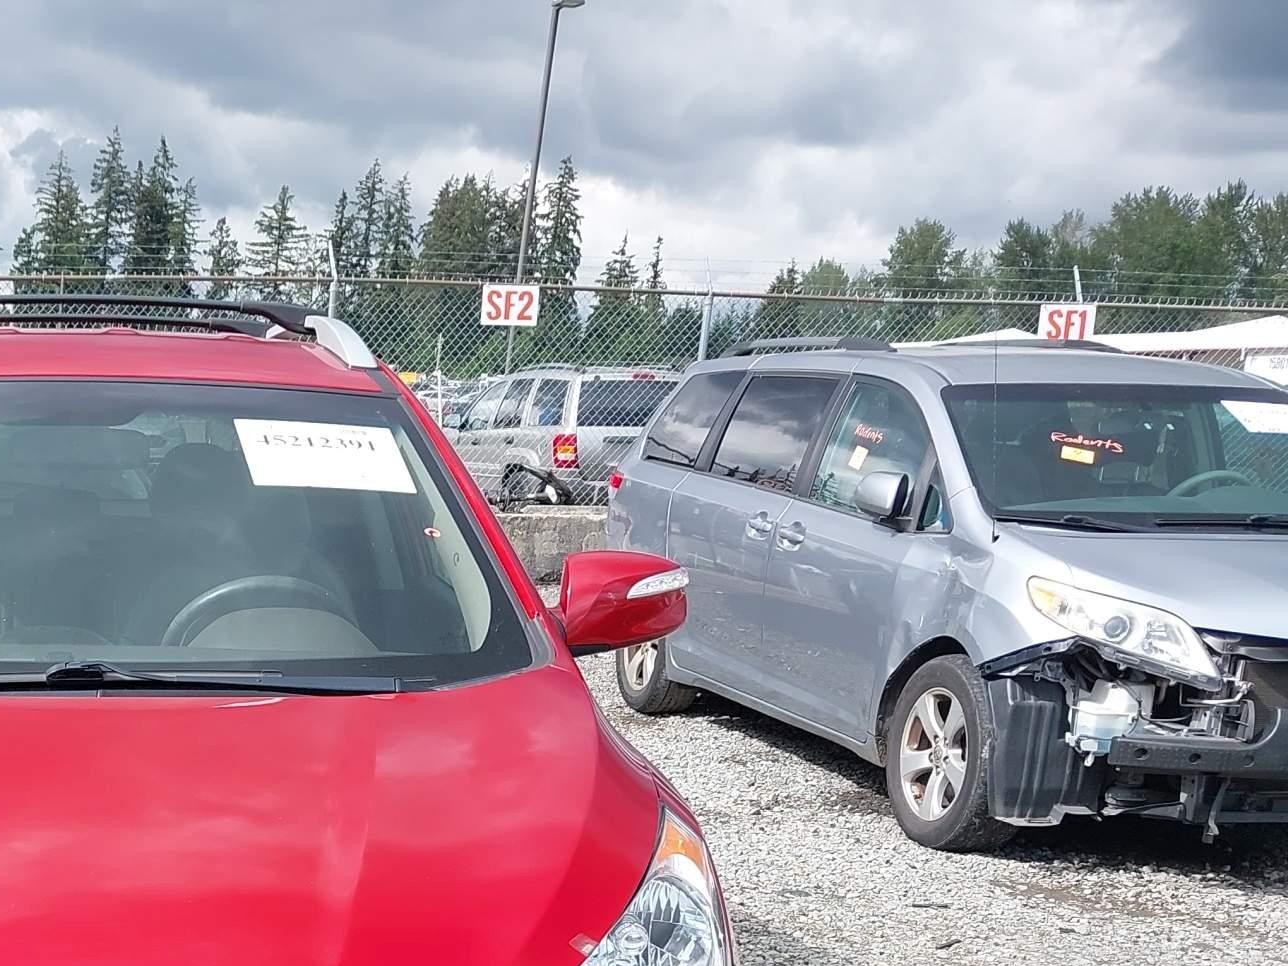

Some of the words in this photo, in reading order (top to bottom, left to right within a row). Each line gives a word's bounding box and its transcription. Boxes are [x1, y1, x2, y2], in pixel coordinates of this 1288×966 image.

[486, 290, 534, 321] SF2
[1046, 309, 1088, 343] SF1
[1050, 431, 1124, 454] Rodents
